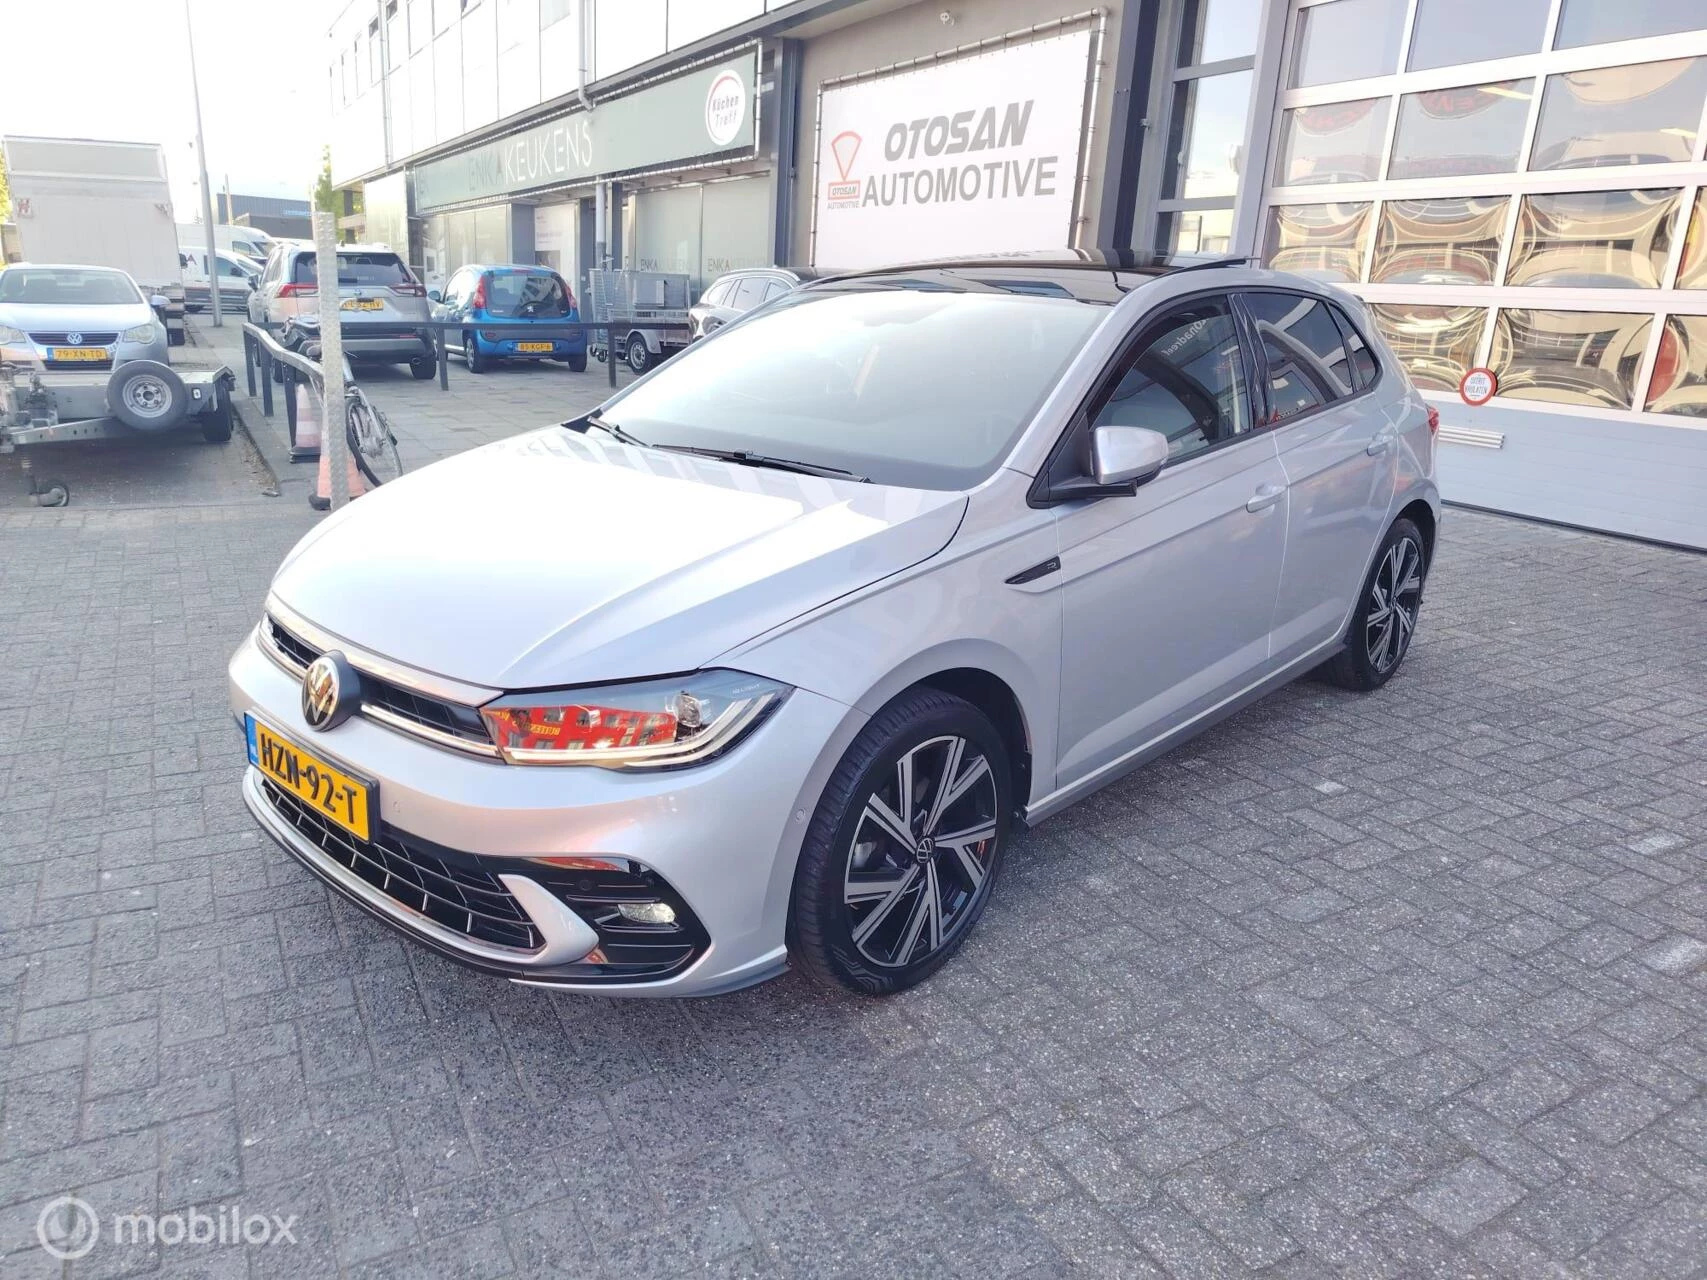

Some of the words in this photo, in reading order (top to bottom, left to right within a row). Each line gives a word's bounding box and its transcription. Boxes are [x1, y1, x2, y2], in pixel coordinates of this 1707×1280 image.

[712, 94, 739, 113] Küchen
[504, 122, 594, 185] KEUKENS
[884, 100, 1034, 162] OTOSAN
[827, 200, 859, 211] AUTOMOTIVE
[831, 185, 858, 196] OTOSAN
[862, 156, 1058, 207] AUTOMOTIVE
[260, 733, 358, 825] HZN-92-T
